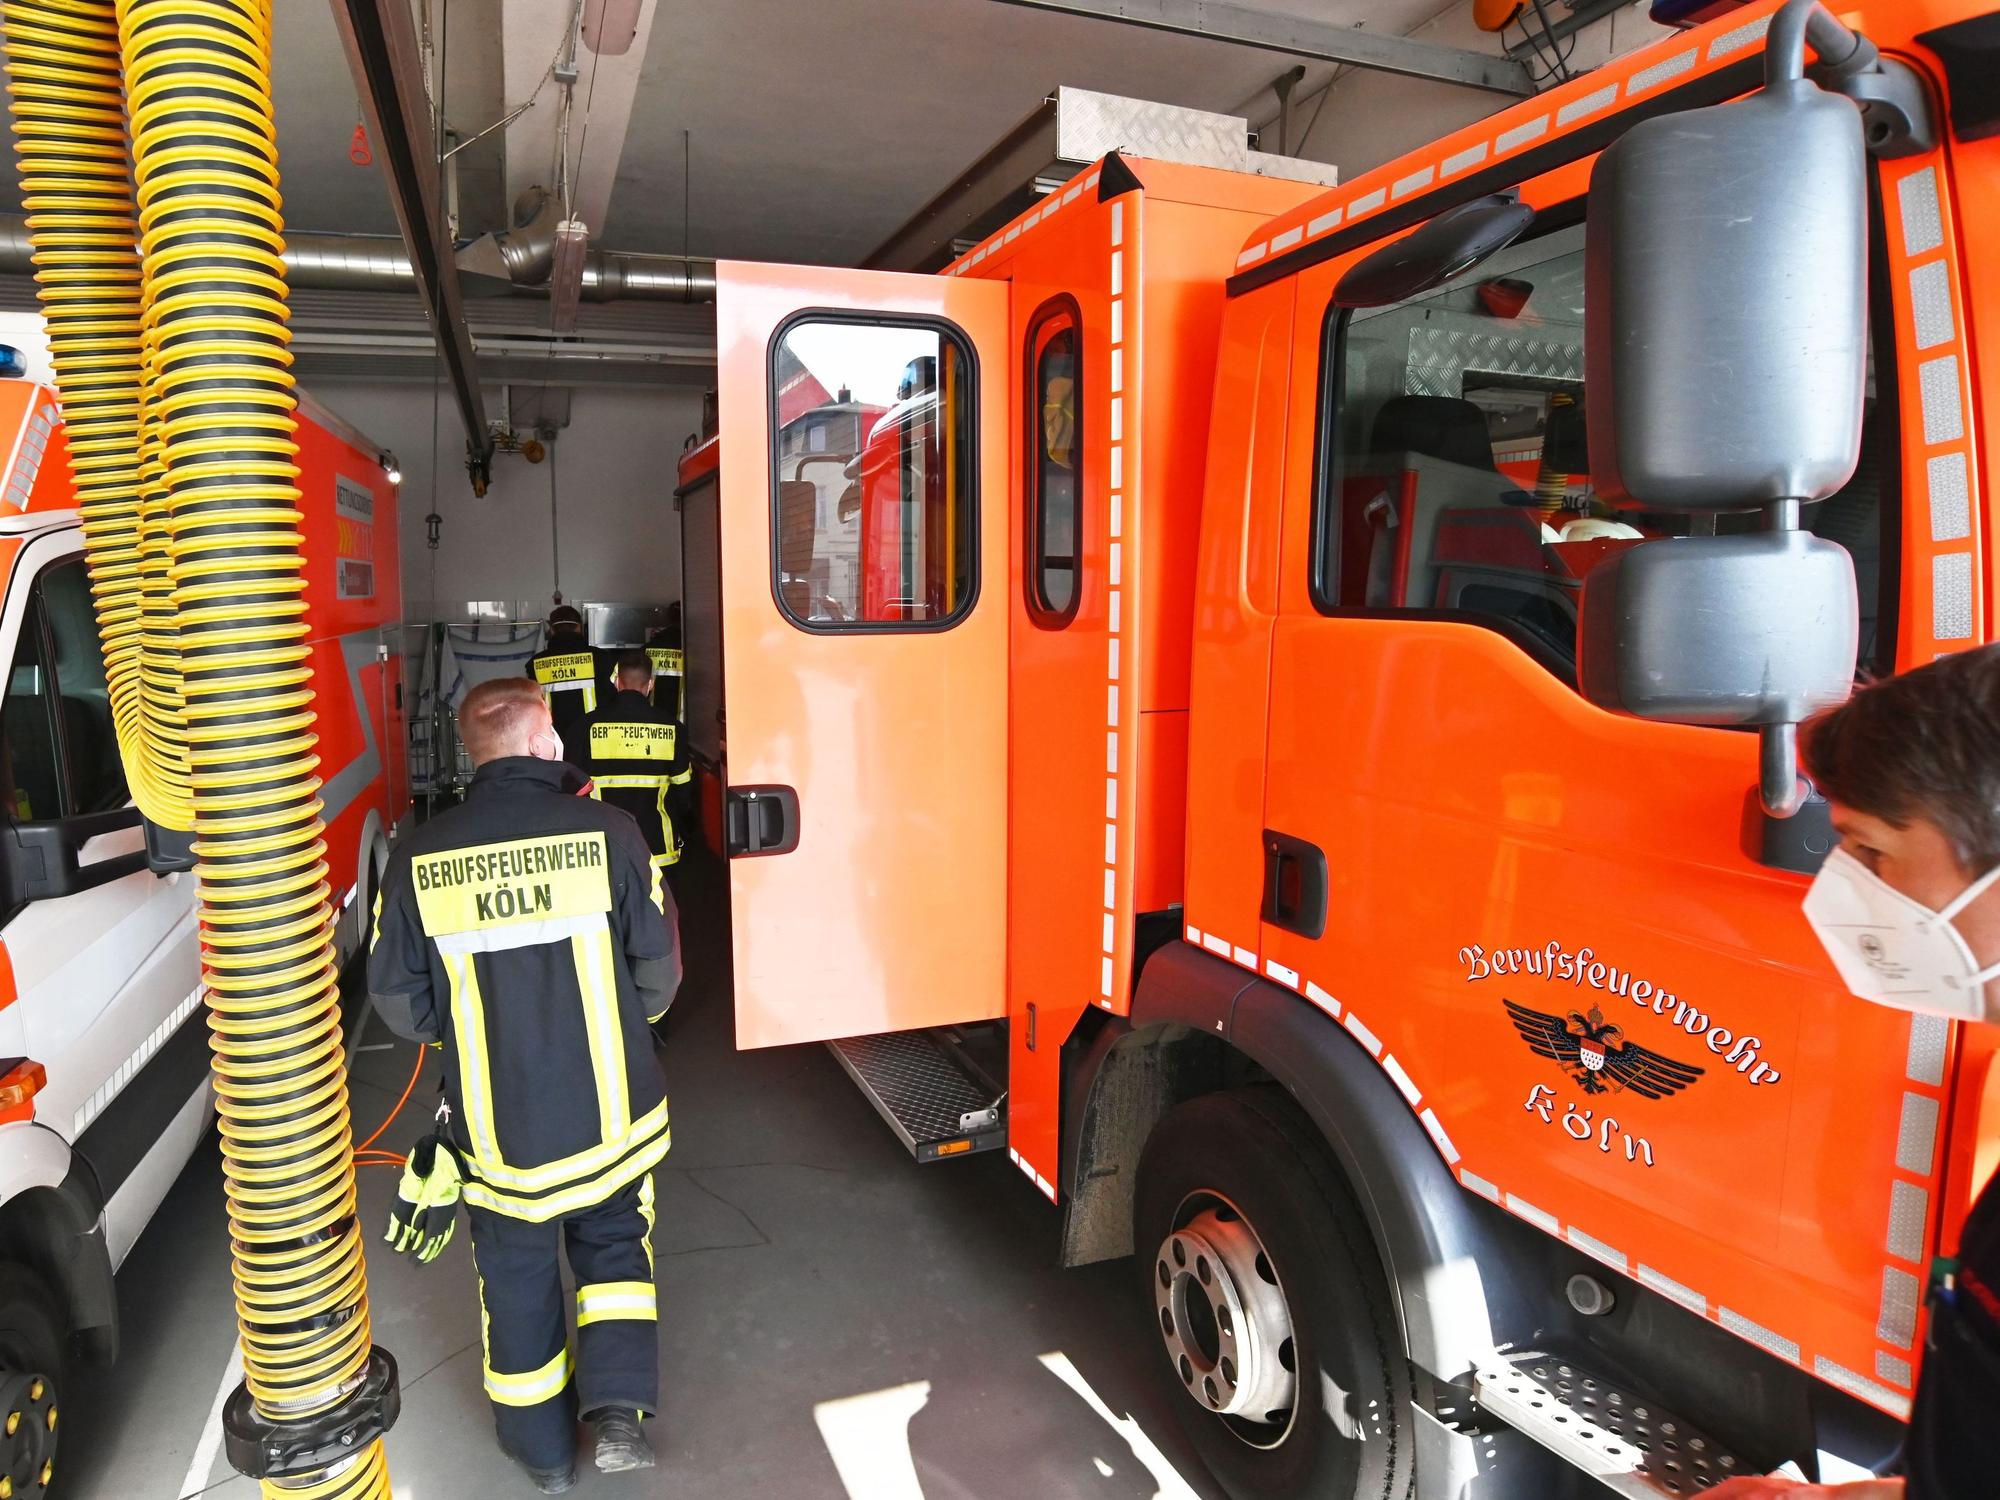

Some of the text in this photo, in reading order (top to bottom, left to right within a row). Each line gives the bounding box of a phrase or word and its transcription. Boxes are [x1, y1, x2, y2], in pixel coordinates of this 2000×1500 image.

[535, 654, 592, 670] BERUFSFEUERWEHR
[417, 840, 602, 891] BERUFSFEUERWEHR
[475, 882, 553, 921] KÖLN
[1458, 940, 1782, 1086] Berufsfeuerwehr
[1523, 1083, 1655, 1168] Köln
